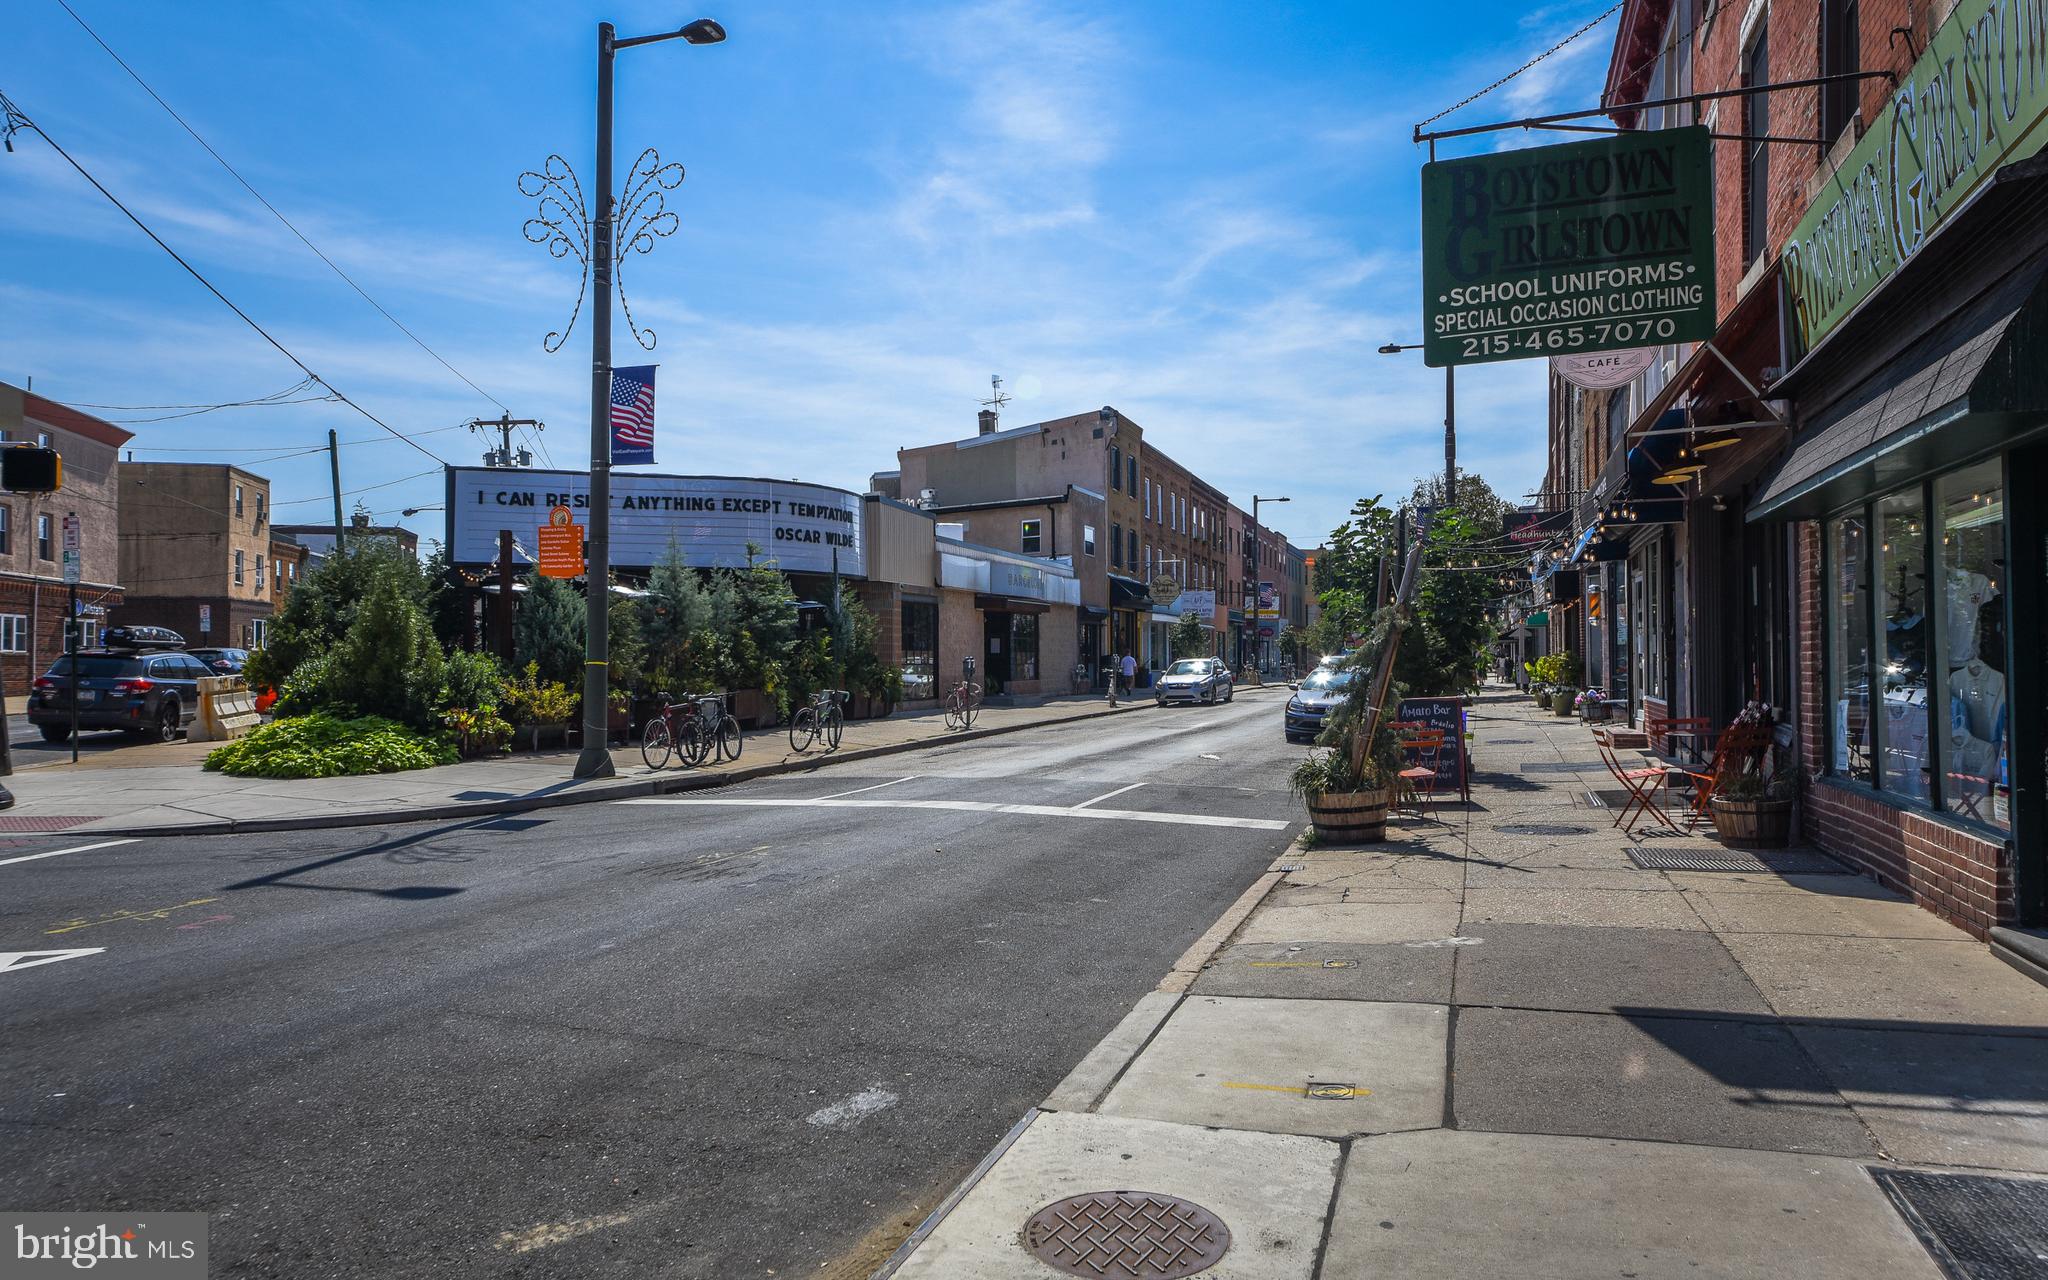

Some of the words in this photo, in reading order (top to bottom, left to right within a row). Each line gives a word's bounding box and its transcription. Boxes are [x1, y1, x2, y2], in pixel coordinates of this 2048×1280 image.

[1449, 145, 1676, 226] BOYSTOWN
[1446, 205, 1693, 282] GIRLSTOWN
[1434, 306, 1507, 333] SPECIAL
[1510, 295, 1604, 324] OCCASION
[1608, 284, 1703, 312] CLOTHING
[1462, 318, 1676, 358] 215-465-7070
[478, 490, 484, 505] I
[496, 491, 535, 507] CAN
[622, 495, 716, 512] ANYTHING
[722, 497, 782, 514] EXCEPT
[788, 502, 854, 524] TEMPTATION
[775, 527, 821, 544] OSCAR
[825, 531, 854, 547] WILDE
[1433, 703, 1452, 715] Bar
